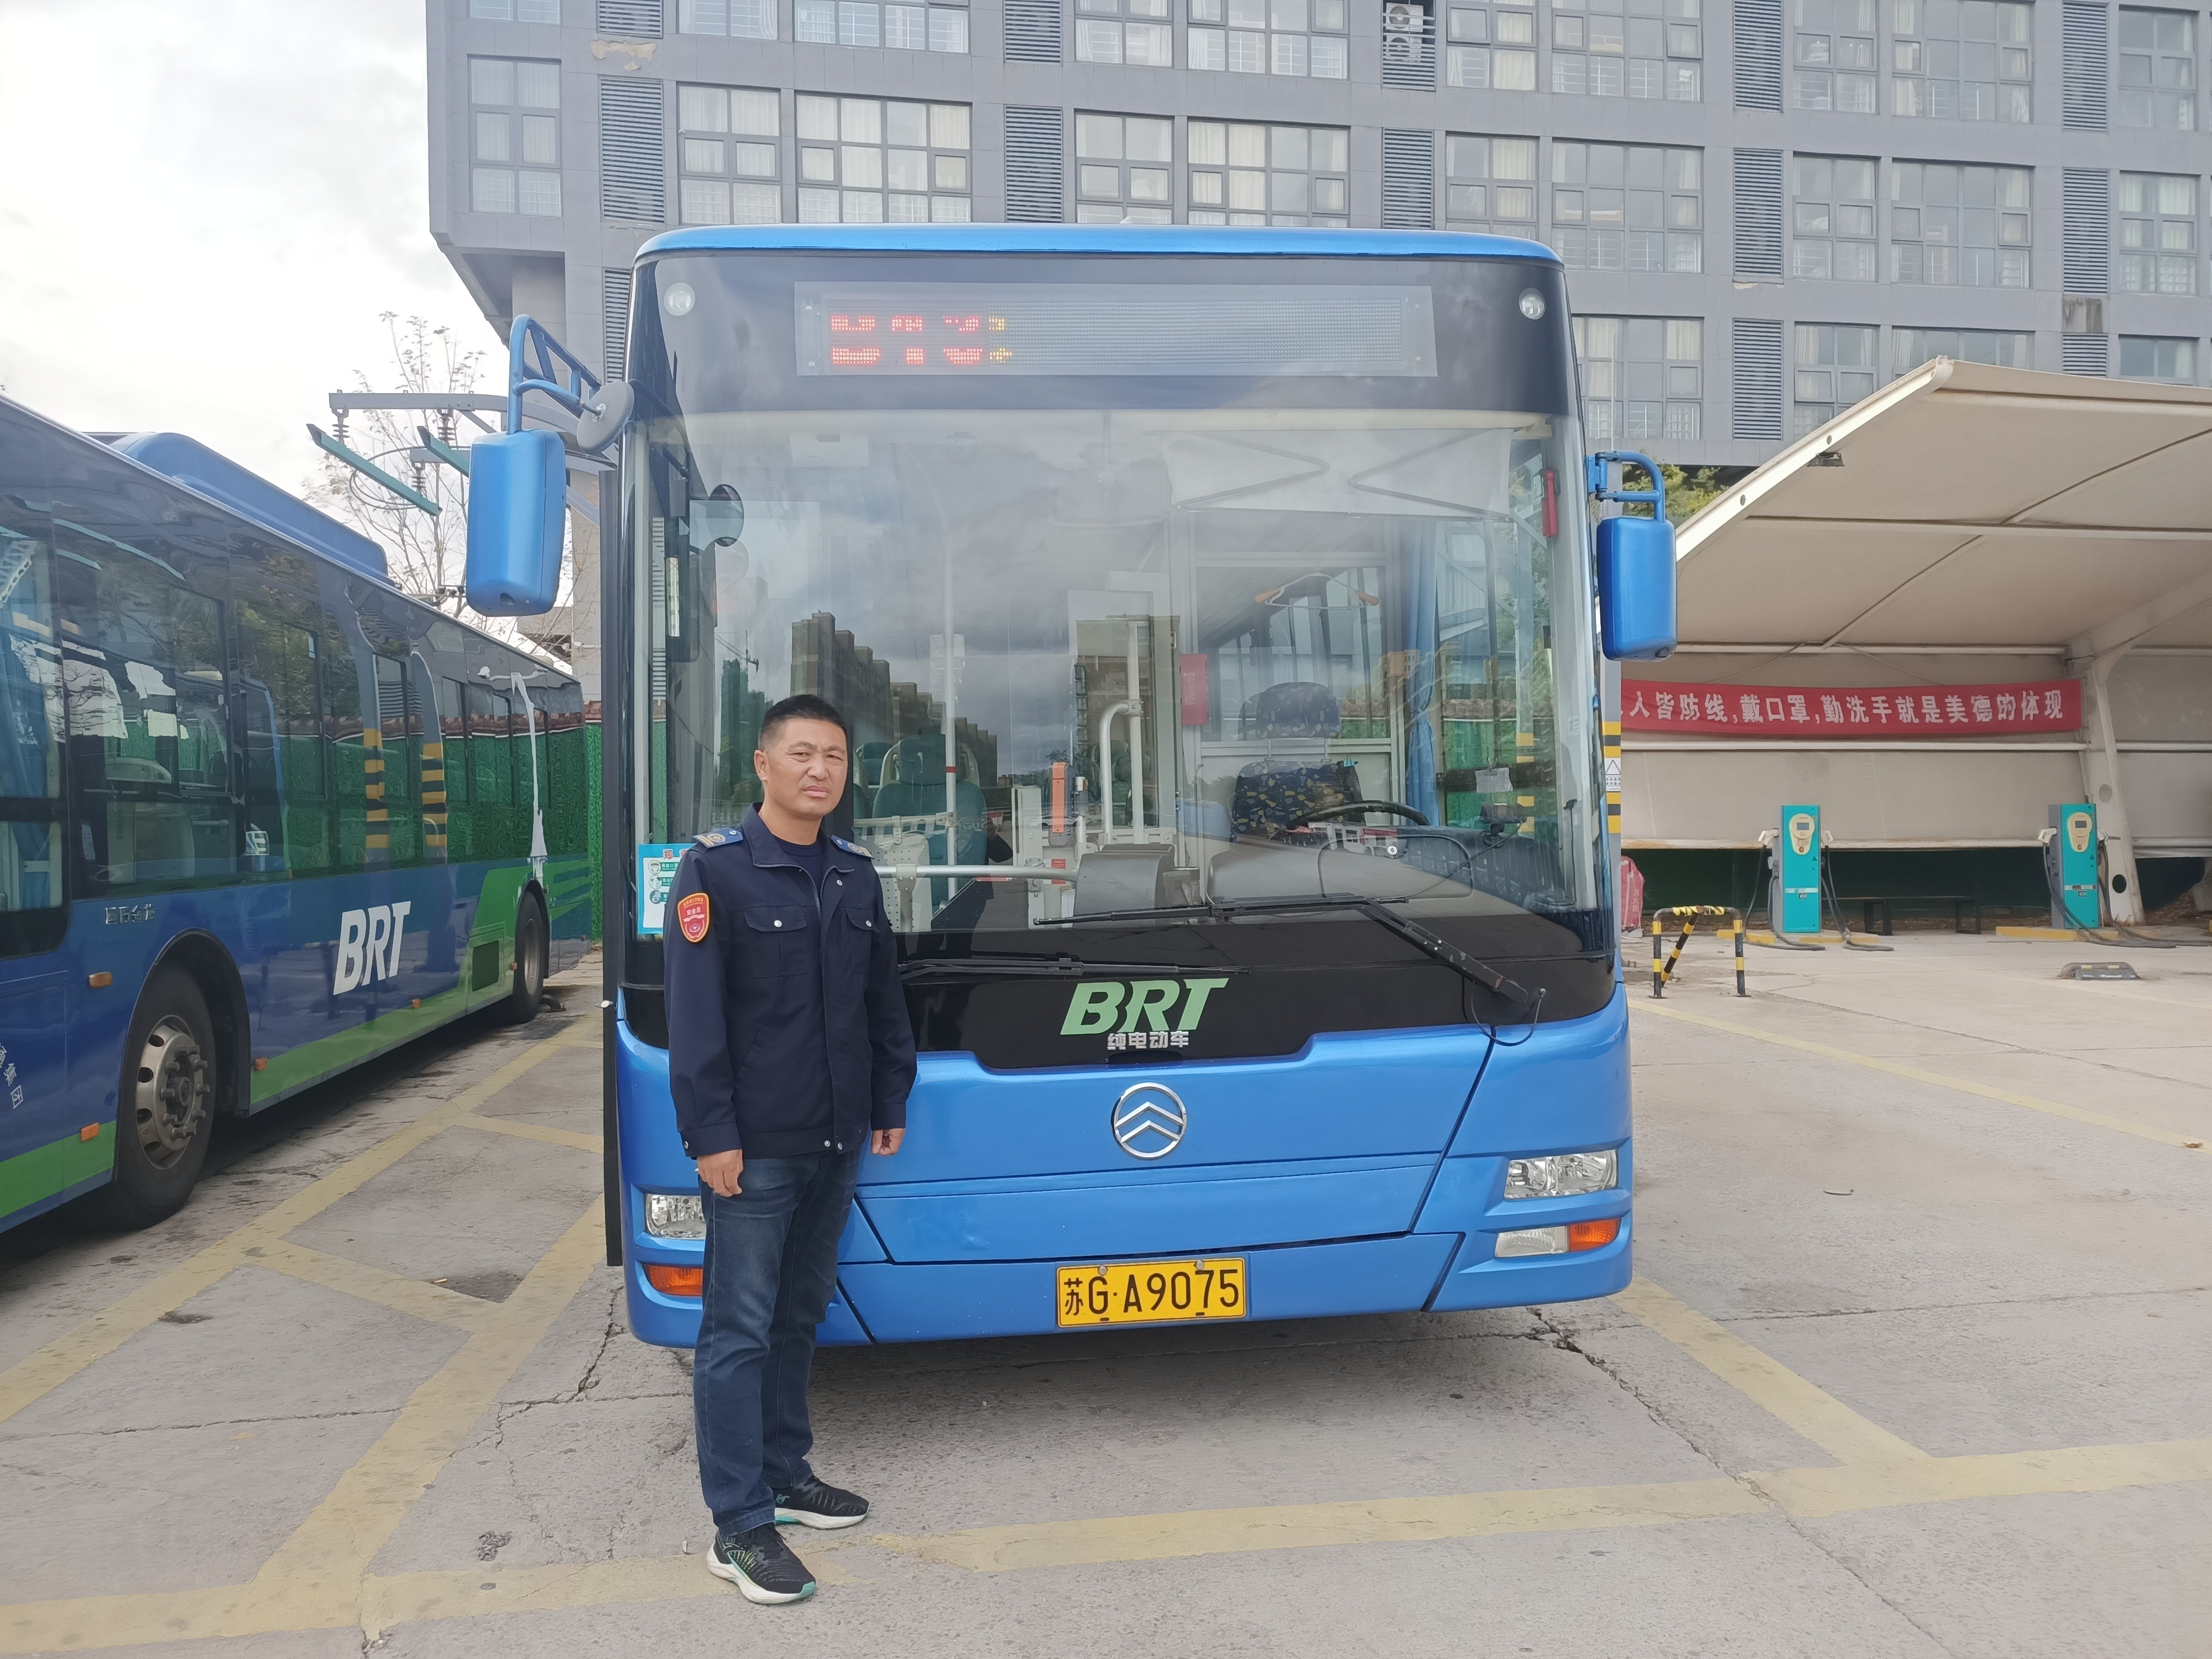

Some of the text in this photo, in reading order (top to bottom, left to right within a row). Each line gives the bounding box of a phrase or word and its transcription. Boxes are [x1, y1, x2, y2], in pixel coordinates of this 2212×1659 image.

[1621, 690, 2064, 725] 人皆防线,戴口罩,勤洗手就是美德的体现
[332, 900, 411, 996] BRT
[1060, 978, 1229, 1035] BRT
[1107, 1031, 1190, 1051] 纯电动车
